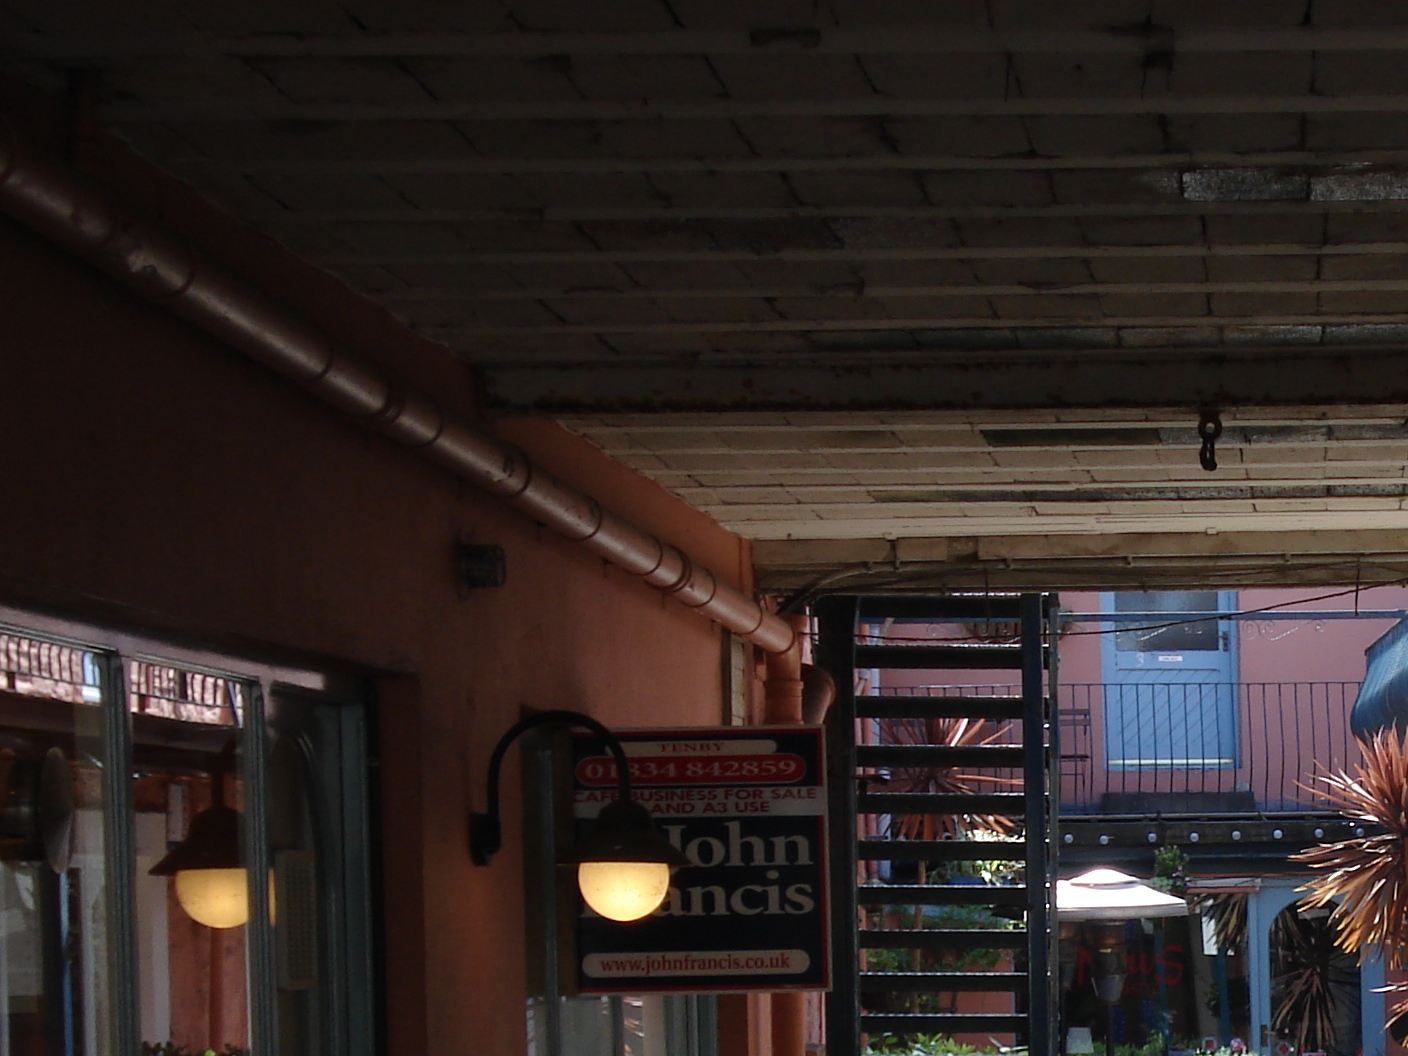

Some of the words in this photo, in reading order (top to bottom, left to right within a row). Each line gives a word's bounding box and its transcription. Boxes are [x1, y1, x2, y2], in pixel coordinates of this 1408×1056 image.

[660, 742, 725, 753] TENBY
[687, 760, 798, 778] 842859
[724, 788, 764, 801] FOR
[771, 787, 817, 800] SALE
[651, 802, 695, 814] AND
[701, 802, 728, 814] A3
[735, 801, 770, 813] USE
[601, 952, 790, 975] www.johnfrancis.co.uk
